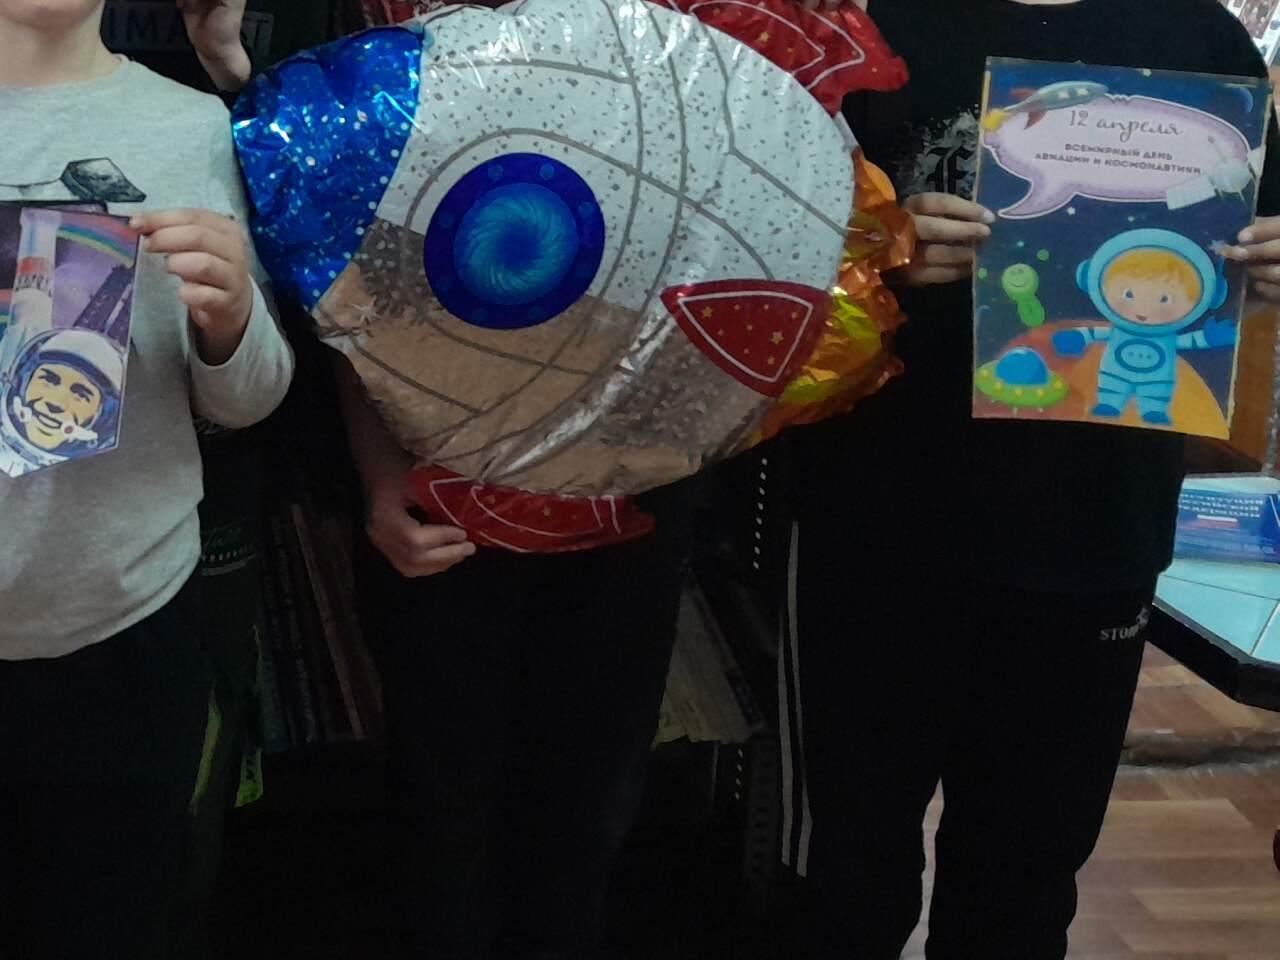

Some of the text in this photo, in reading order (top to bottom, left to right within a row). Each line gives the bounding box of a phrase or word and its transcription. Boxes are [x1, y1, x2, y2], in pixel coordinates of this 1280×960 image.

[1069, 109, 1184, 143] 12 апреля
[1034, 152, 1090, 163] АВИАЦИИ
[1104, 160, 1201, 175] КОСМОНАВТИКИ
[1064, 143, 1173, 161] ВСЕМИРНЫЙ ДЕНЬ
